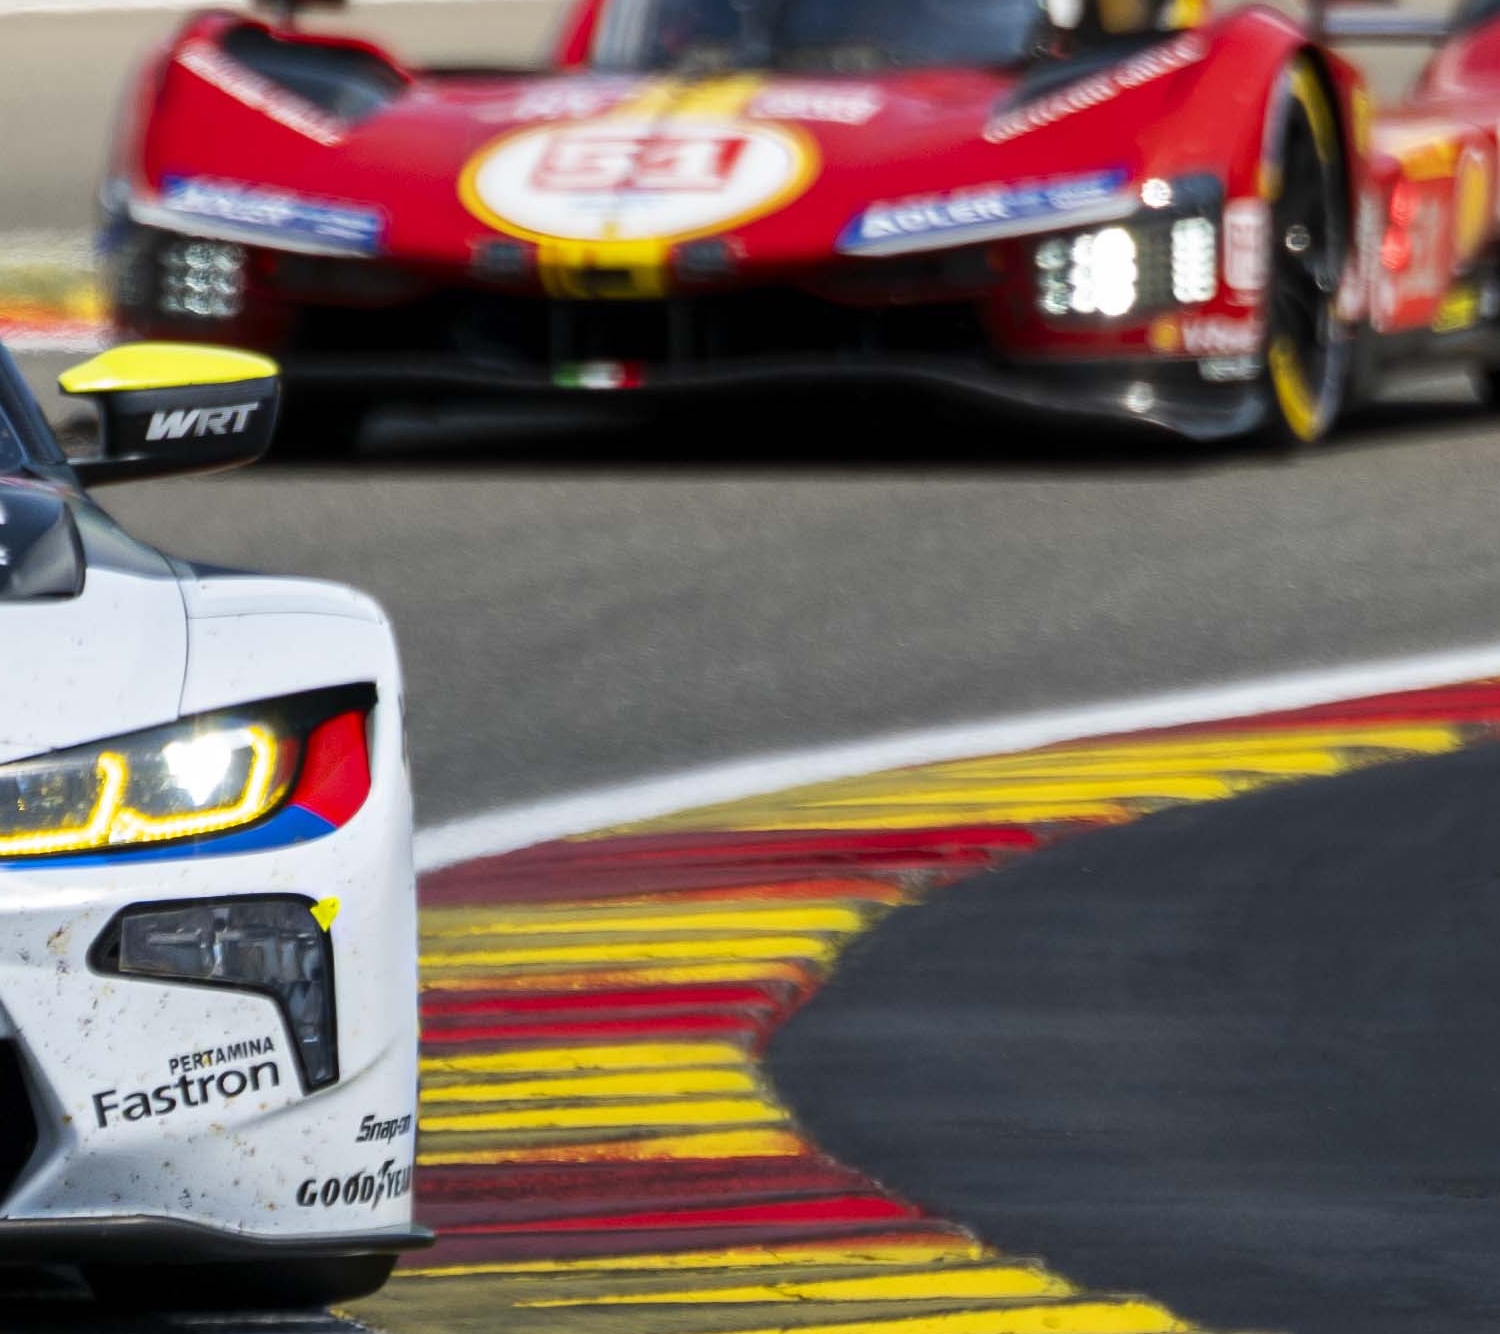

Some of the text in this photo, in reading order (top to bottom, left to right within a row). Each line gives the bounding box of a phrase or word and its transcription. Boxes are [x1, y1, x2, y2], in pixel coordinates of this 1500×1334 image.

[144, 401, 260, 442] WRT
[168, 1035, 276, 1076] PERTAMINA
[91, 1060, 281, 1129] Fastron
